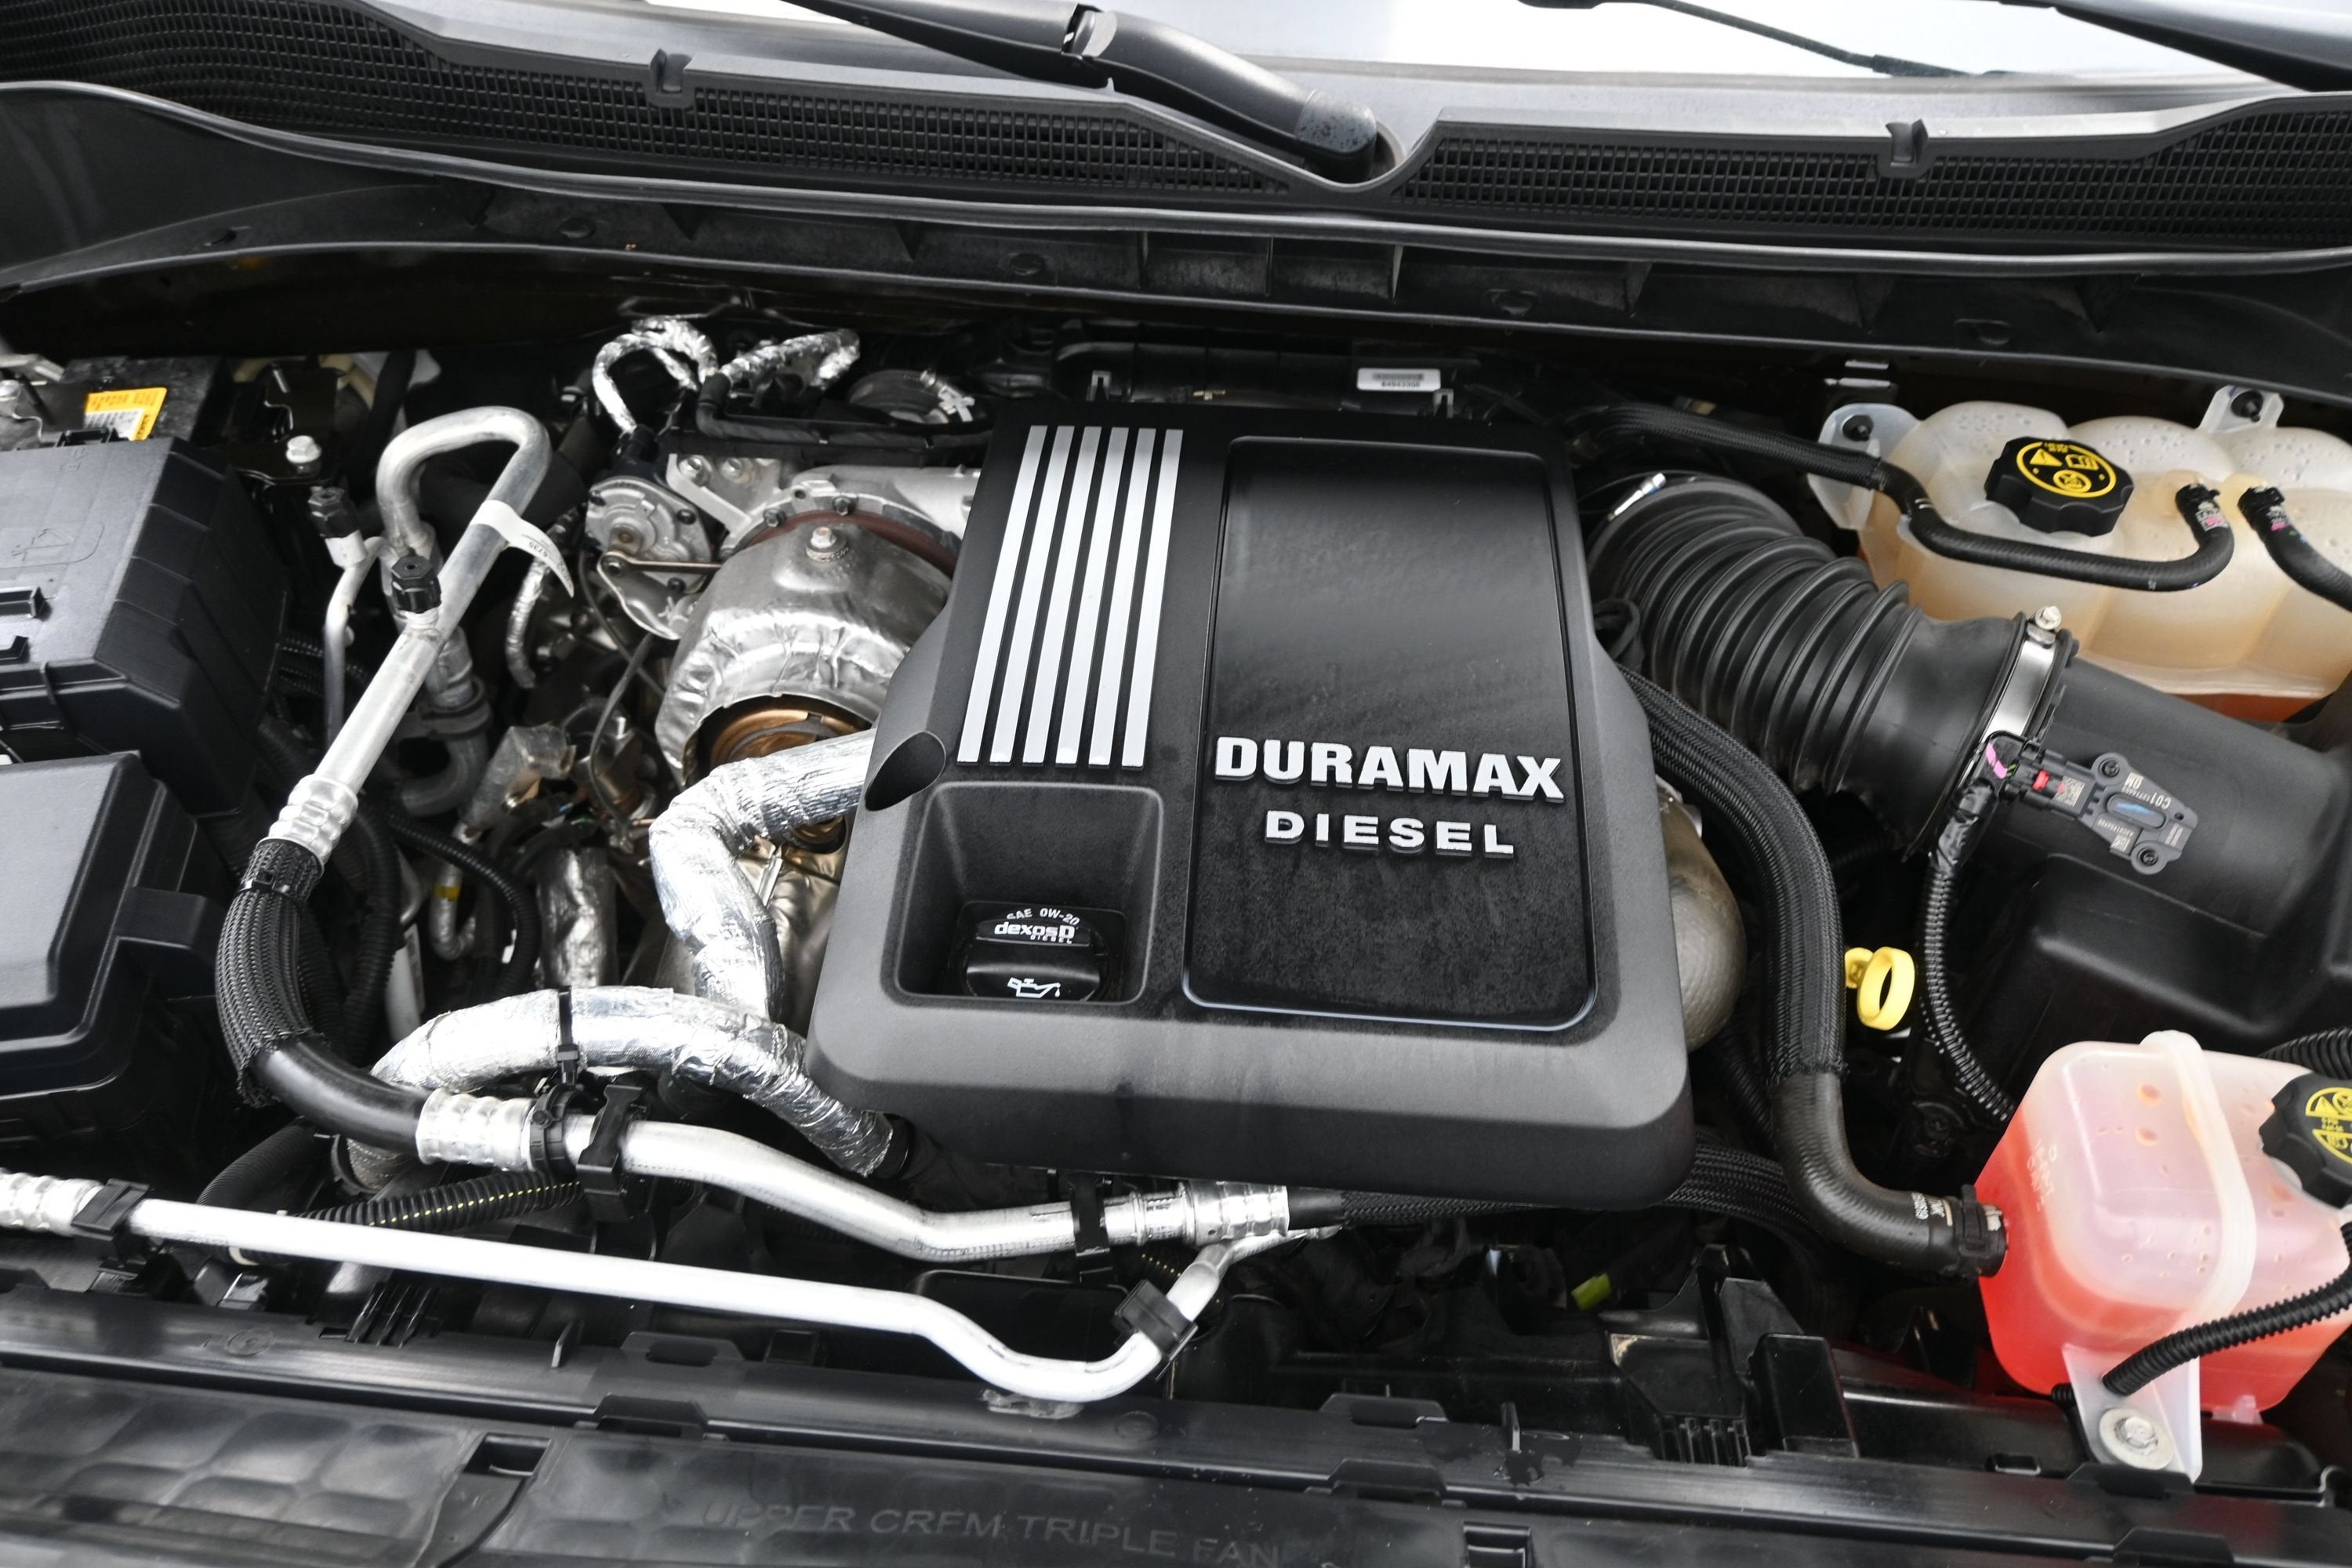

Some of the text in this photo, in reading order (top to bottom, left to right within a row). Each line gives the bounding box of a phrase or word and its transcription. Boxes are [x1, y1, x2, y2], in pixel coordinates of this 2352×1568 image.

[1215, 736, 1565, 801] DURAMAX
[1264, 809, 1514, 858] DIESEL
[1007, 908, 1080, 926] SAE 0W-20
[702, 1501, 857, 1532] UPPER
[1017, 1515, 1180, 1558] TRIPLE
[1192, 1537, 1279, 1568] FAN
